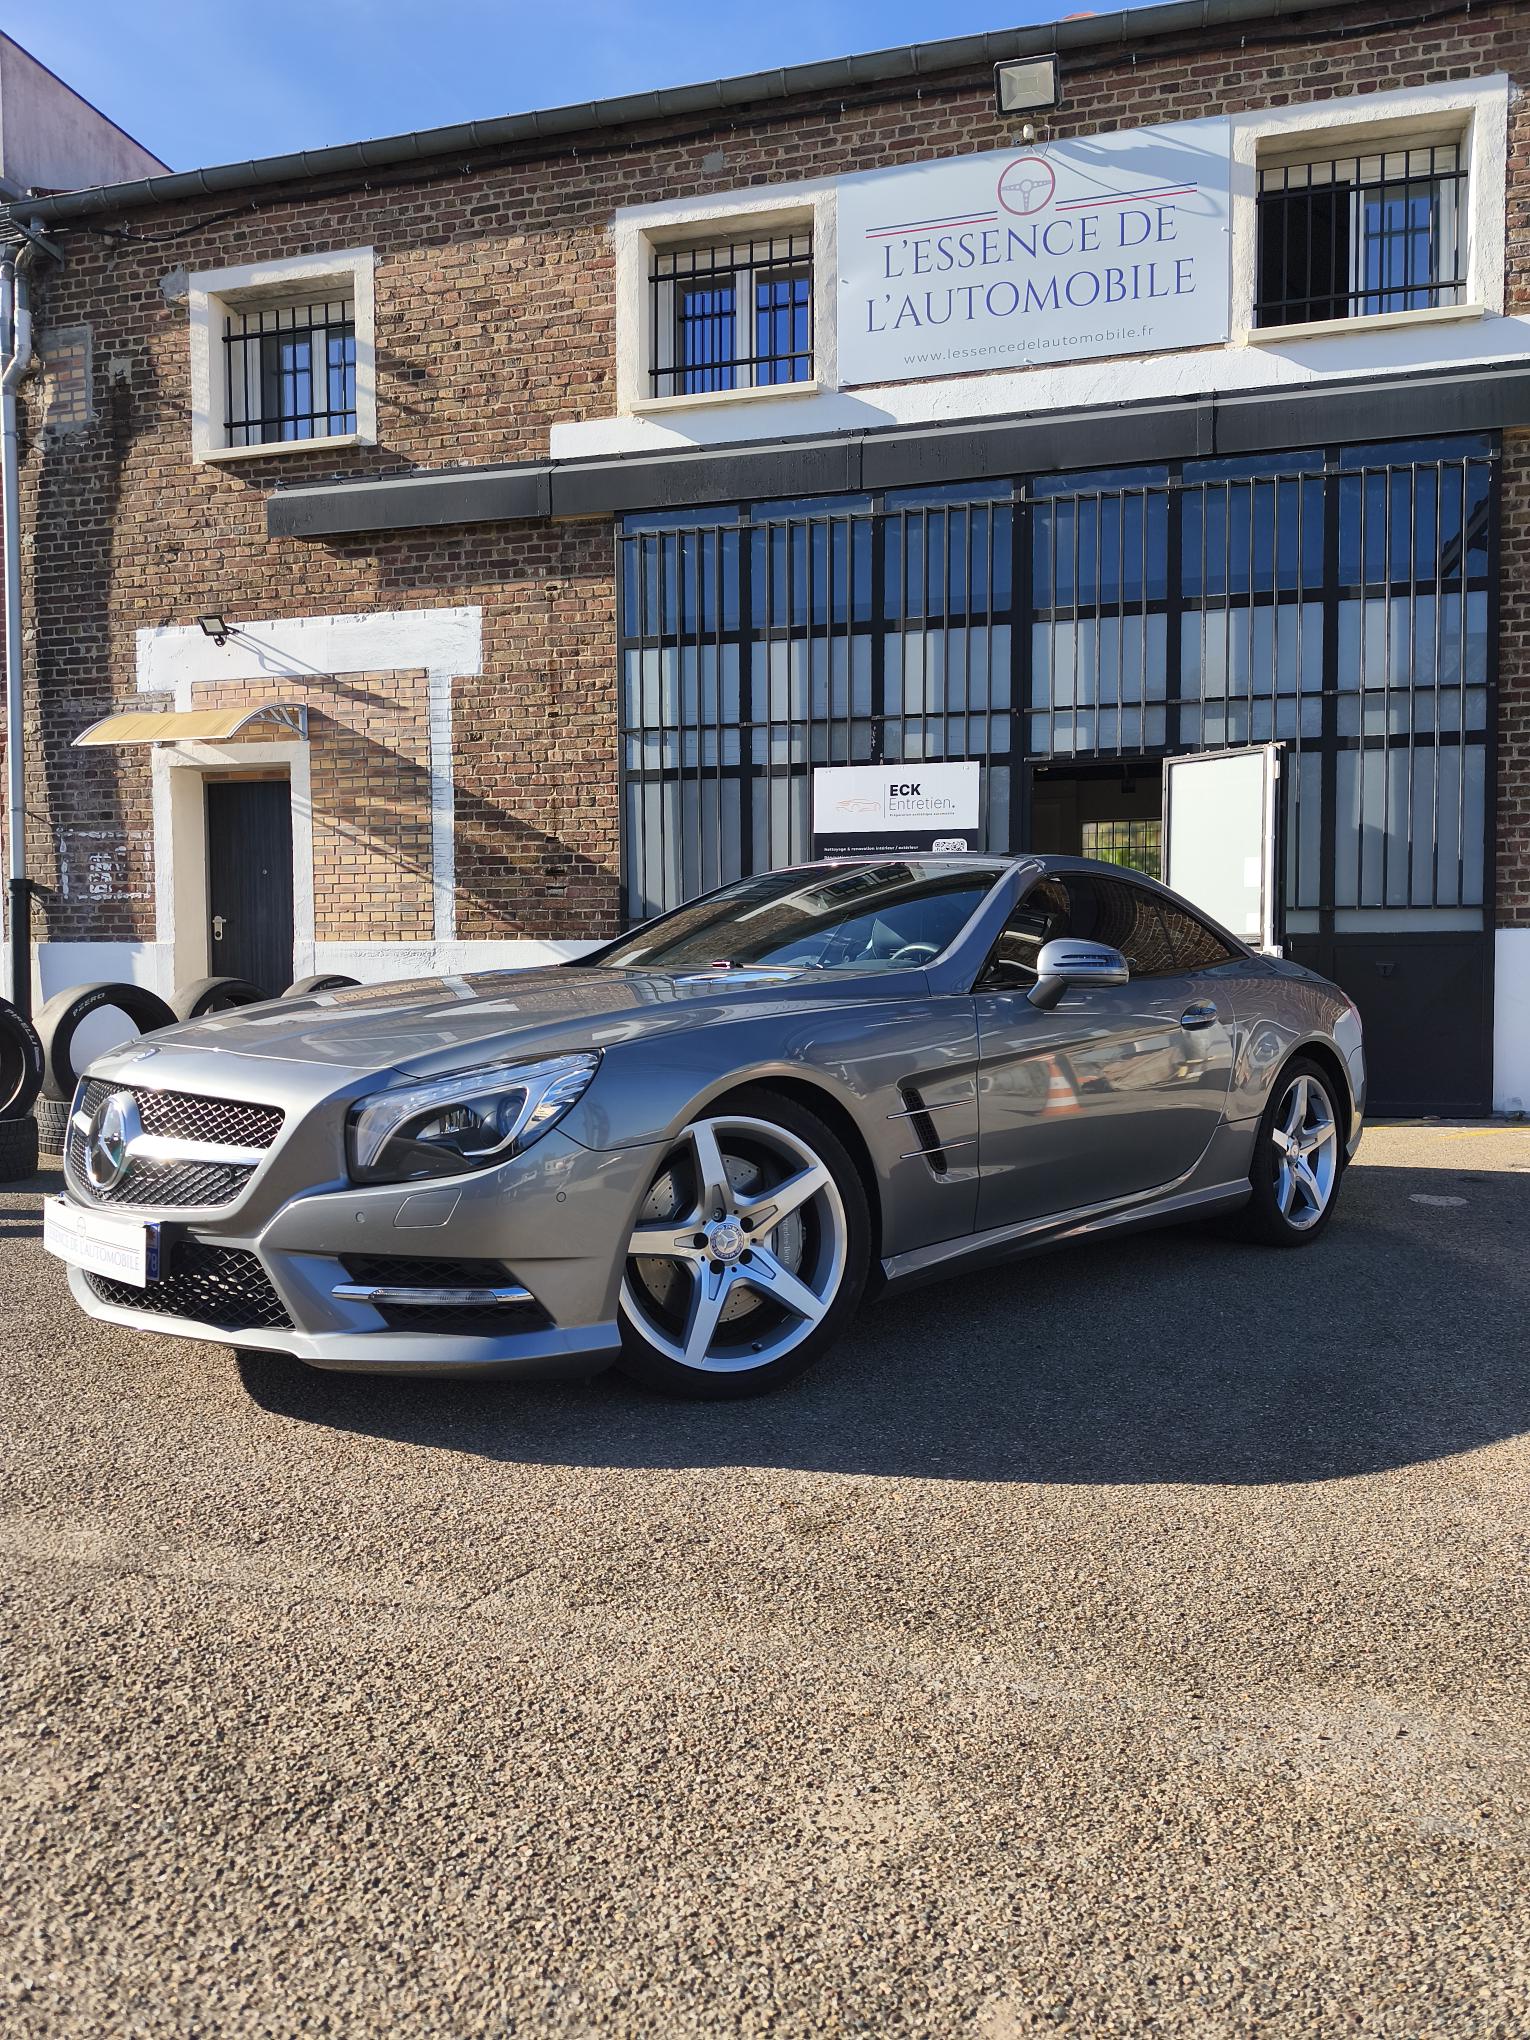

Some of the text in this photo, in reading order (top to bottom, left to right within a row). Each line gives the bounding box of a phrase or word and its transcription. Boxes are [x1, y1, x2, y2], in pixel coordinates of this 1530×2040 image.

[882, 204, 1179, 280] L'ESSENCE DE
[865, 257, 1197, 334] L'AUTOMOBILE
[903, 324, 1155, 366] www.lessencedelautomobile.fr
[888, 797, 956, 811] Entretien.
[889, 783, 921, 797] ECK
